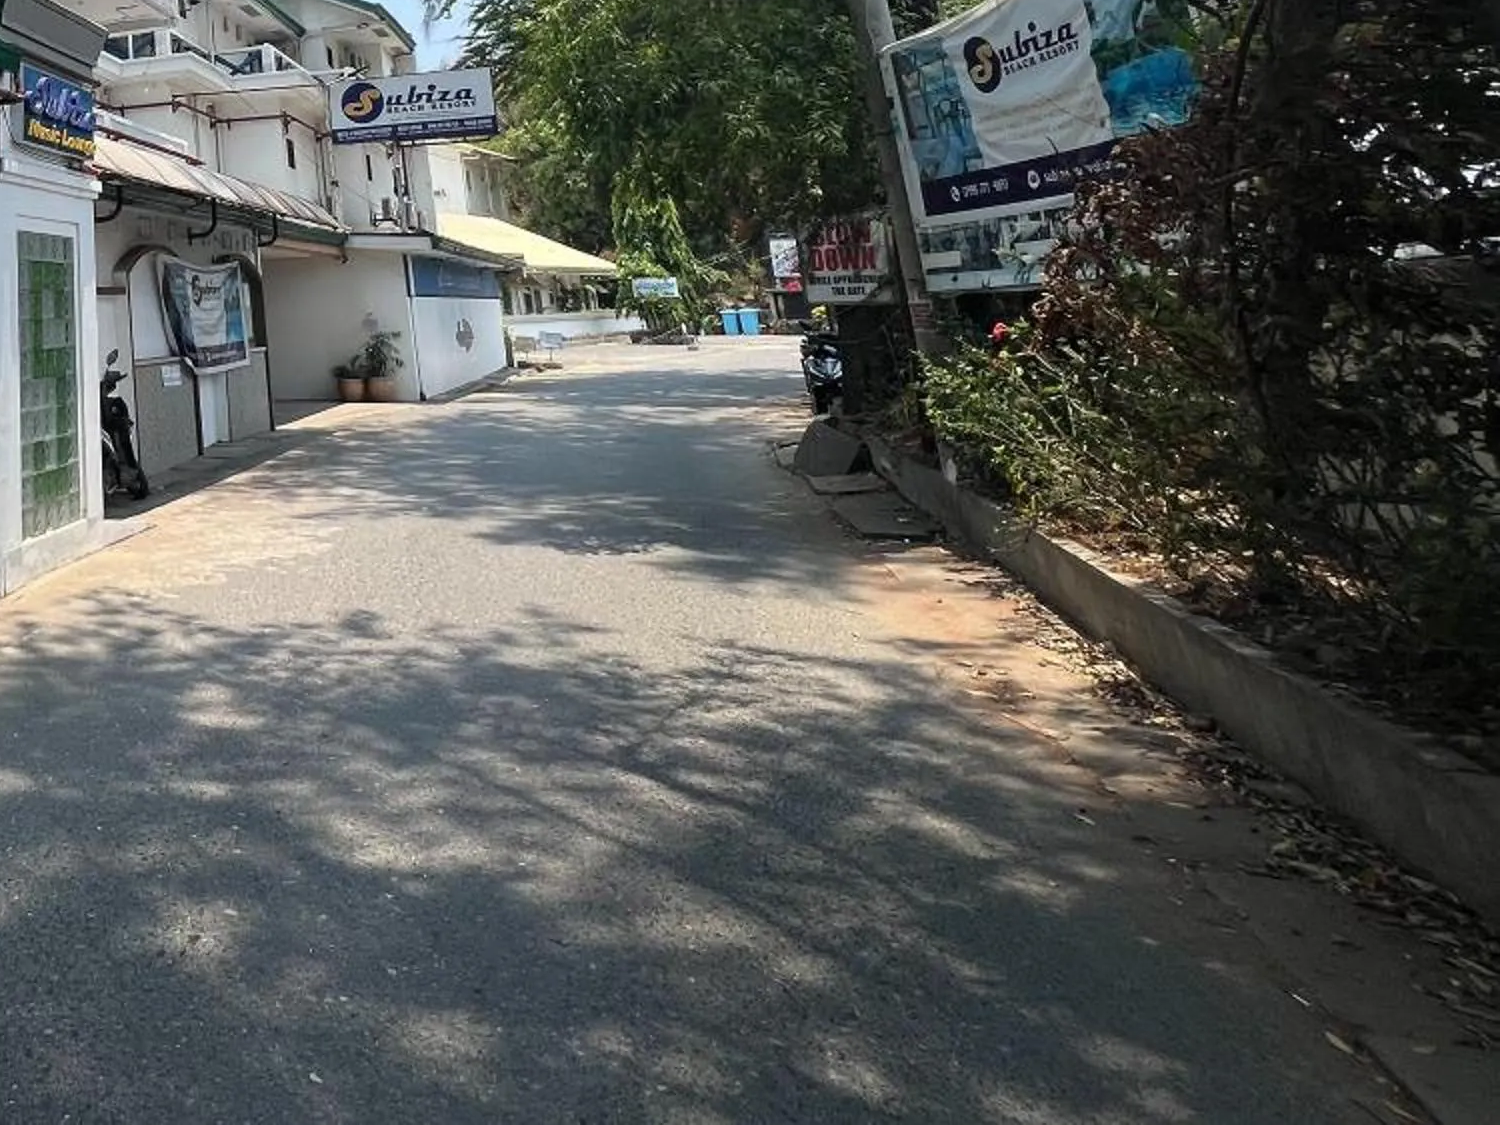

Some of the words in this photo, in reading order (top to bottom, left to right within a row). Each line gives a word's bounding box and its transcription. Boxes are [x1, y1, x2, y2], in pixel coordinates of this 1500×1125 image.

[968, 21, 1080, 85] Subiza
[1003, 57, 1037, 76] BEACH
[1040, 40, 1080, 63] RESORT
[343, 83, 475, 118] Subiza
[386, 104, 426, 115] BEACH
[431, 97, 477, 111] RESORT
[810, 245, 877, 272] DOWN
